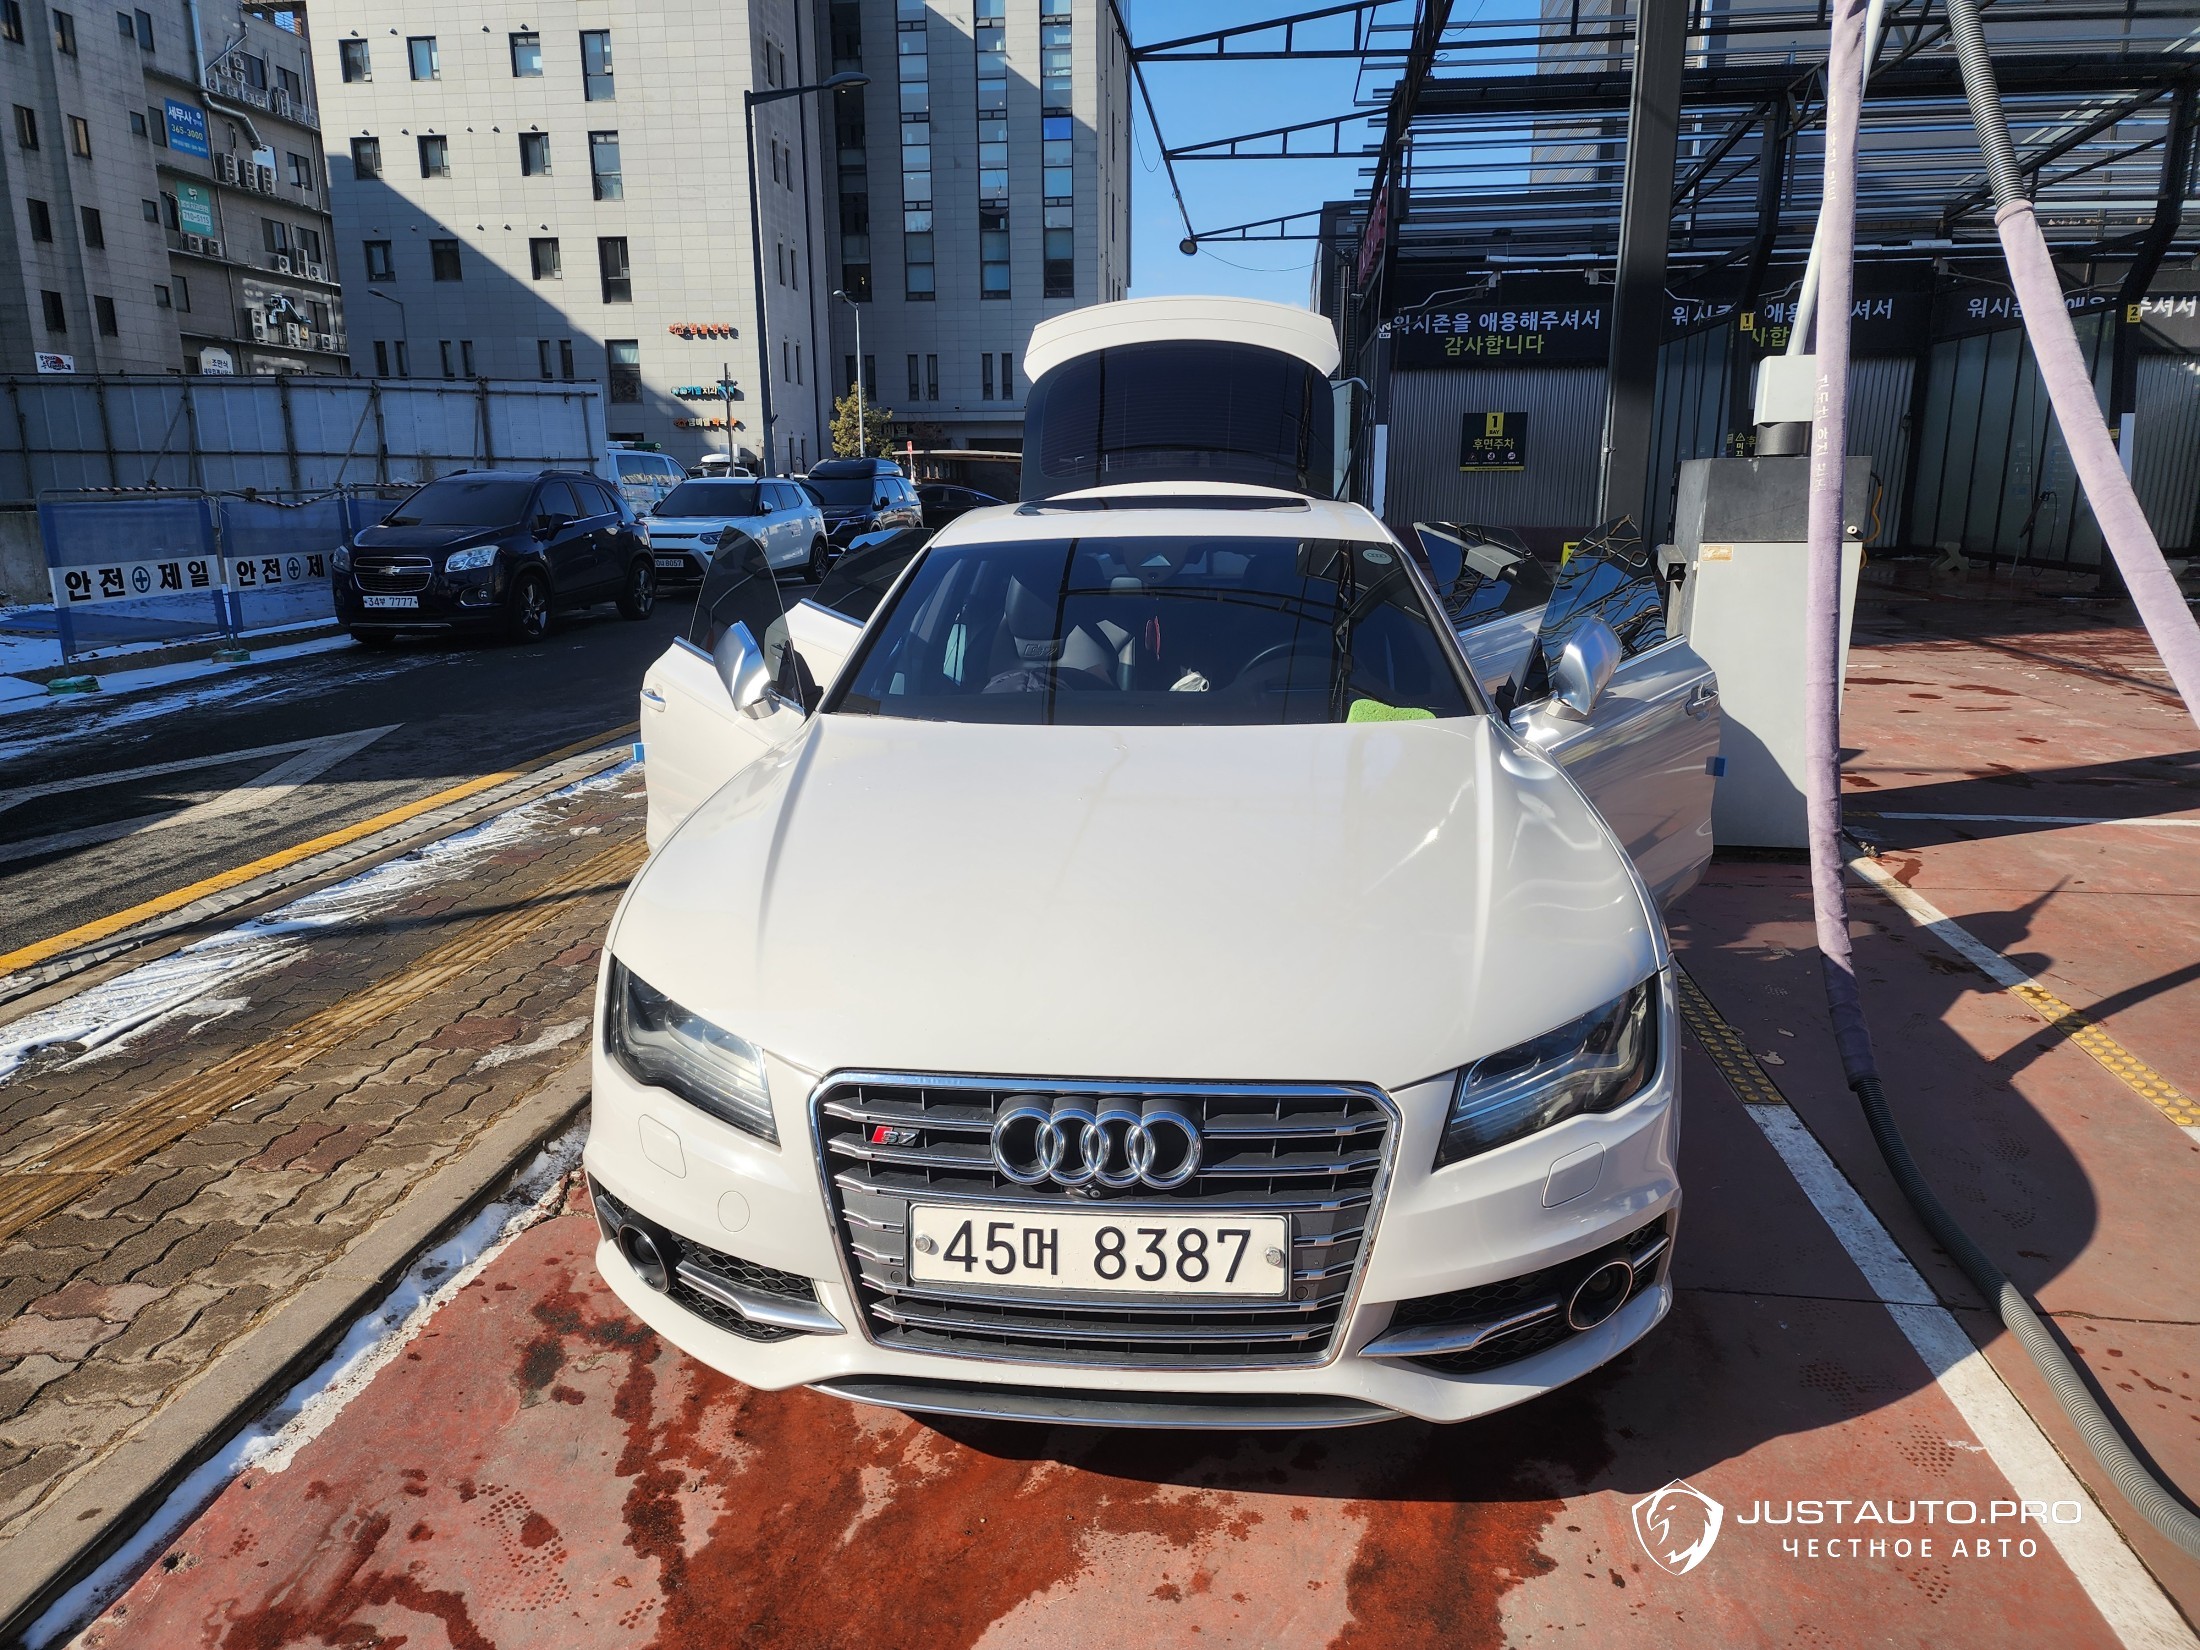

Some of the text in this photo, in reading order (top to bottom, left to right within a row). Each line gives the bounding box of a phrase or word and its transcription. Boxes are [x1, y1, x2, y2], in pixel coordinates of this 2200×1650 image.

[168, 105, 192, 124] 세무사
[171, 123, 204, 140] 365-3000
[1744, 315, 1750, 324] 1
[2130, 306, 2138, 316] 2
[1392, 312, 1472, 334] 워시존을
[1479, 309, 1600, 333] 애용해주셔서
[1444, 334, 1545, 356] 감사합니다
[1492, 415, 1498, 428] 1
[1472, 438, 1515, 450] 후면주차
[65, 560, 210, 602] 안전 제일
[236, 558, 282, 587] 안전
[389, 597, 413, 607] 7777
[943, 1219, 1251, 1283] 45머 8387
